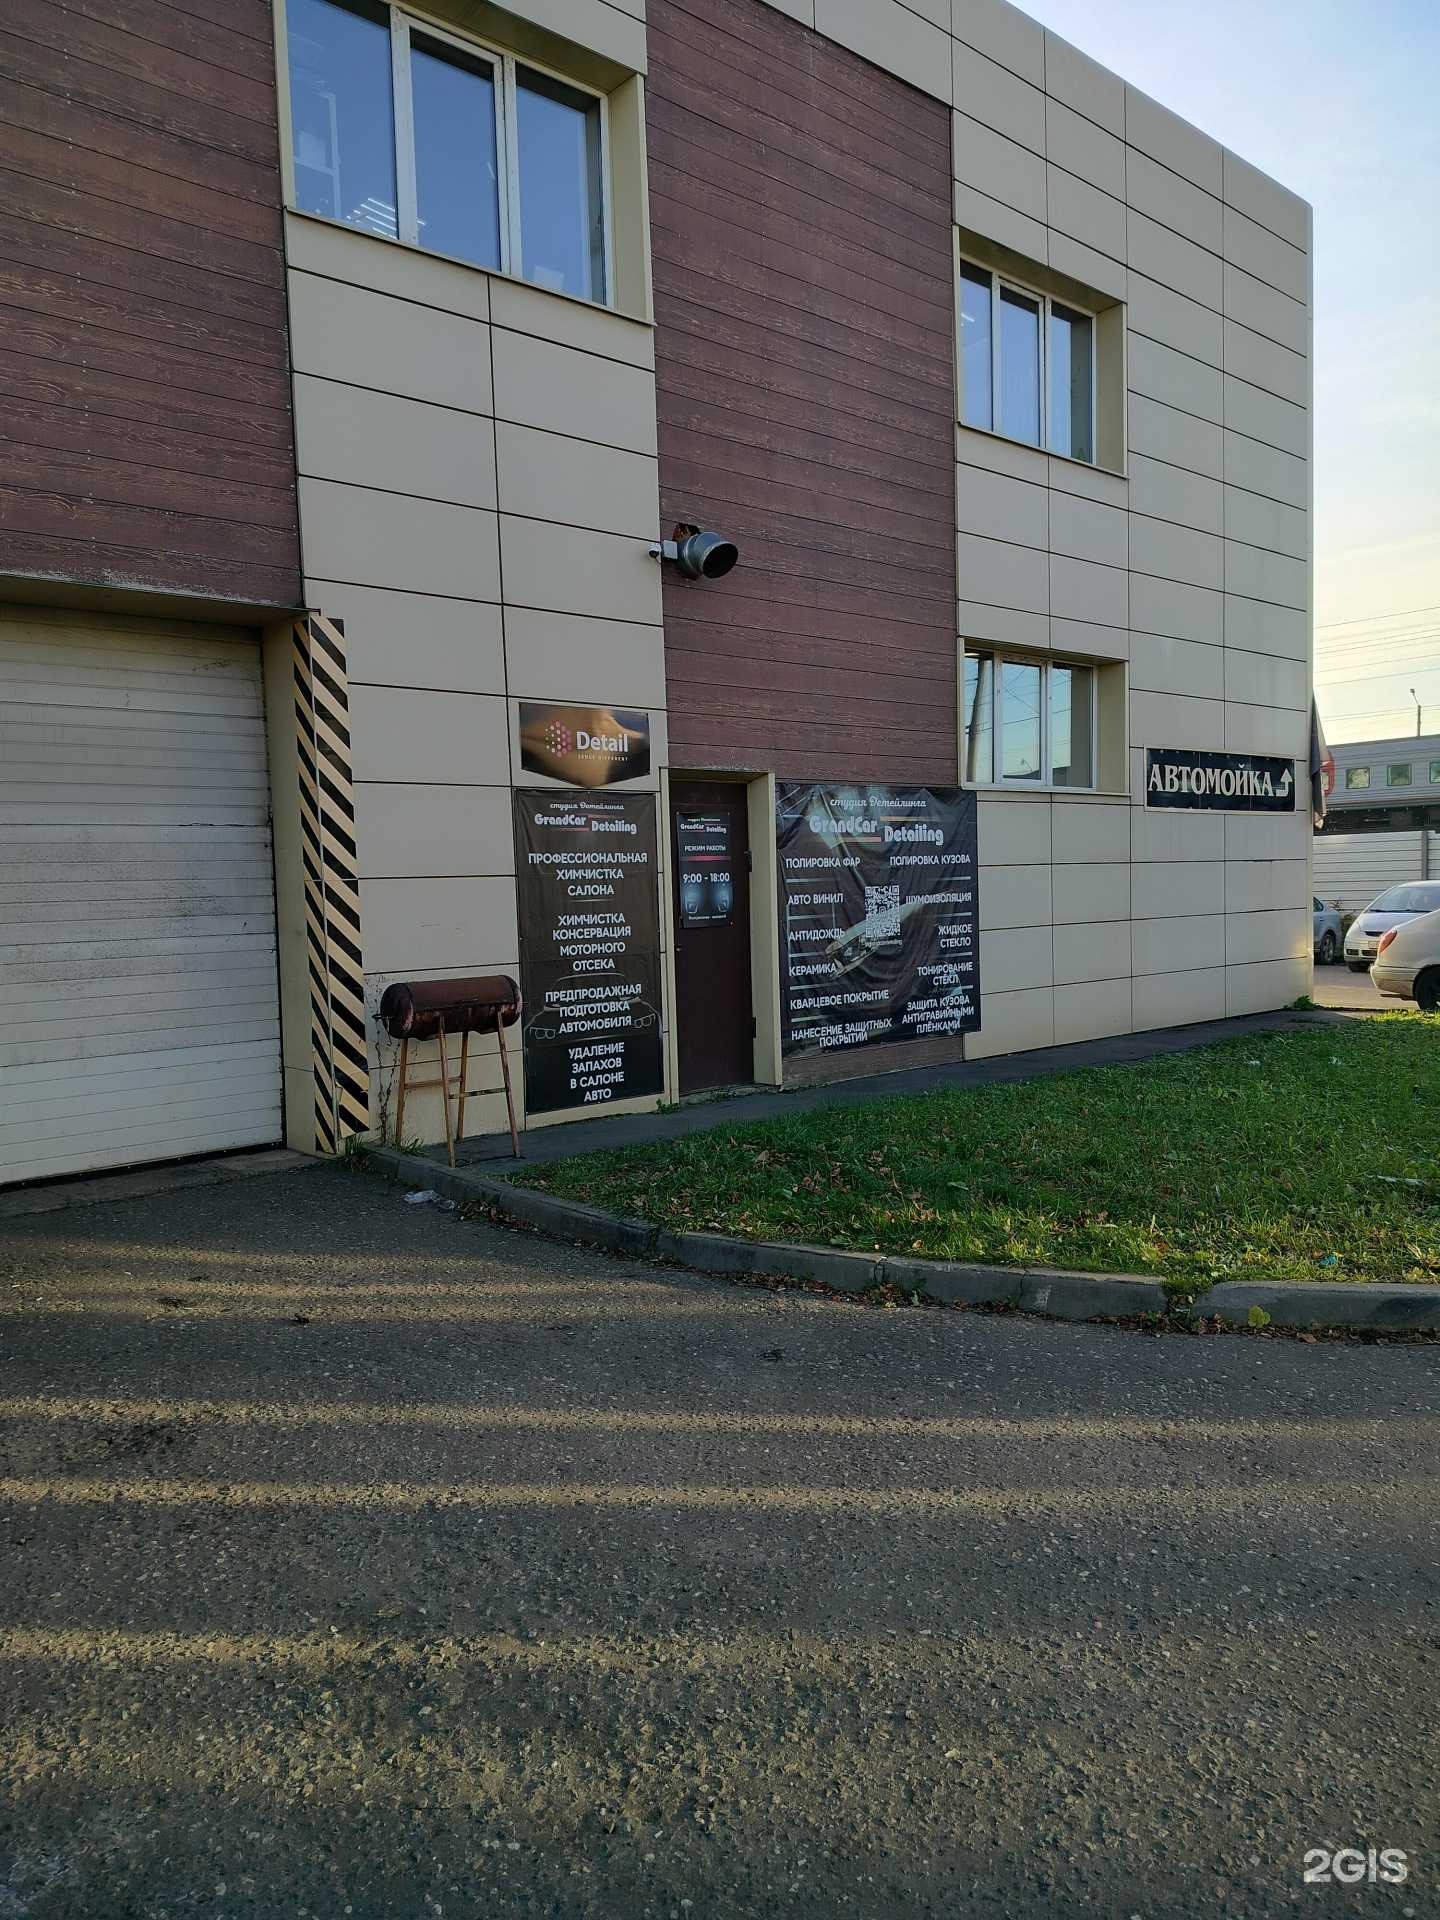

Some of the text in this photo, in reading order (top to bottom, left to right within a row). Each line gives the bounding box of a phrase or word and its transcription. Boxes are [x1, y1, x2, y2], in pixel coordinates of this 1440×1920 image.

[576, 731, 629, 753] Detail
[1148, 763, 1274, 797] АВТОМОЙКА
[830, 797, 867, 810] студия
[534, 813, 587, 826] GrandCar
[809, 815, 878, 834] GrandCar
[591, 820, 638, 835] Detailing
[884, 823, 944, 846] Detailing
[528, 852, 648, 865] ПРОФЕССИОНАЛЬНАЯ
[786, 856, 861, 869] ПОЛИРОВКА ФАР
[890, 854, 971, 866] ПОЛИРОВКА КУЗОВА
[556, 868, 625, 881] ХИМЧИСТКА
[683, 873, 702, 883] 9:00
[710, 872, 730, 882] 18:00
[567, 884, 615, 897] САЛОНА
[905, 891, 972, 905] ШУМОИЗОЛЯЦИЯ
[788, 893, 843, 905] АВТО ВИНИЛ
[558, 912, 626, 927] ХИМЧИСТКА
[552, 925, 632, 941] КОНСЕРВАЦИЯ
[789, 927, 845, 942] АНТИДОЖДЬ
[938, 923, 973, 935] ЖИДКОЕ
[559, 941, 626, 957] МОТОРНОГО
[940, 936, 971, 948] СТЕКЛО
[572, 958, 616, 972] ОТСЕКА
[789, 962, 837, 977] КЕРАМИКА
[917, 961, 974, 976] ТОНИРОВАНИЕ
[545, 983, 642, 1003] ПРЕДПРОДАЖНАЯ
[790, 989, 889, 1010] КВАРЦЕВОЕ ПОКРЫТИЕ
[559, 1000, 630, 1018] ПОДГОТОВКА
[906, 994, 970, 1011] ЗАЩИТА КУЗОВА
[902, 1006, 975, 1024] АНТИГРАВИЙНЫМИ
[558, 1015, 632, 1034] АВТОМОБИЛЯ
[791, 1017, 893, 1041] НАНЕСЕНИЕ ЗАЩИТНЫХ
[916, 1019, 961, 1034] ПЛЁНКАМИ
[568, 1041, 625, 1060] УДАЛЕНИЕ
[571, 1057, 622, 1074] ЗАПАХОВ
[570, 1071, 625, 1089] В САЛОНЕ
[583, 1087, 612, 1103] АВТО
